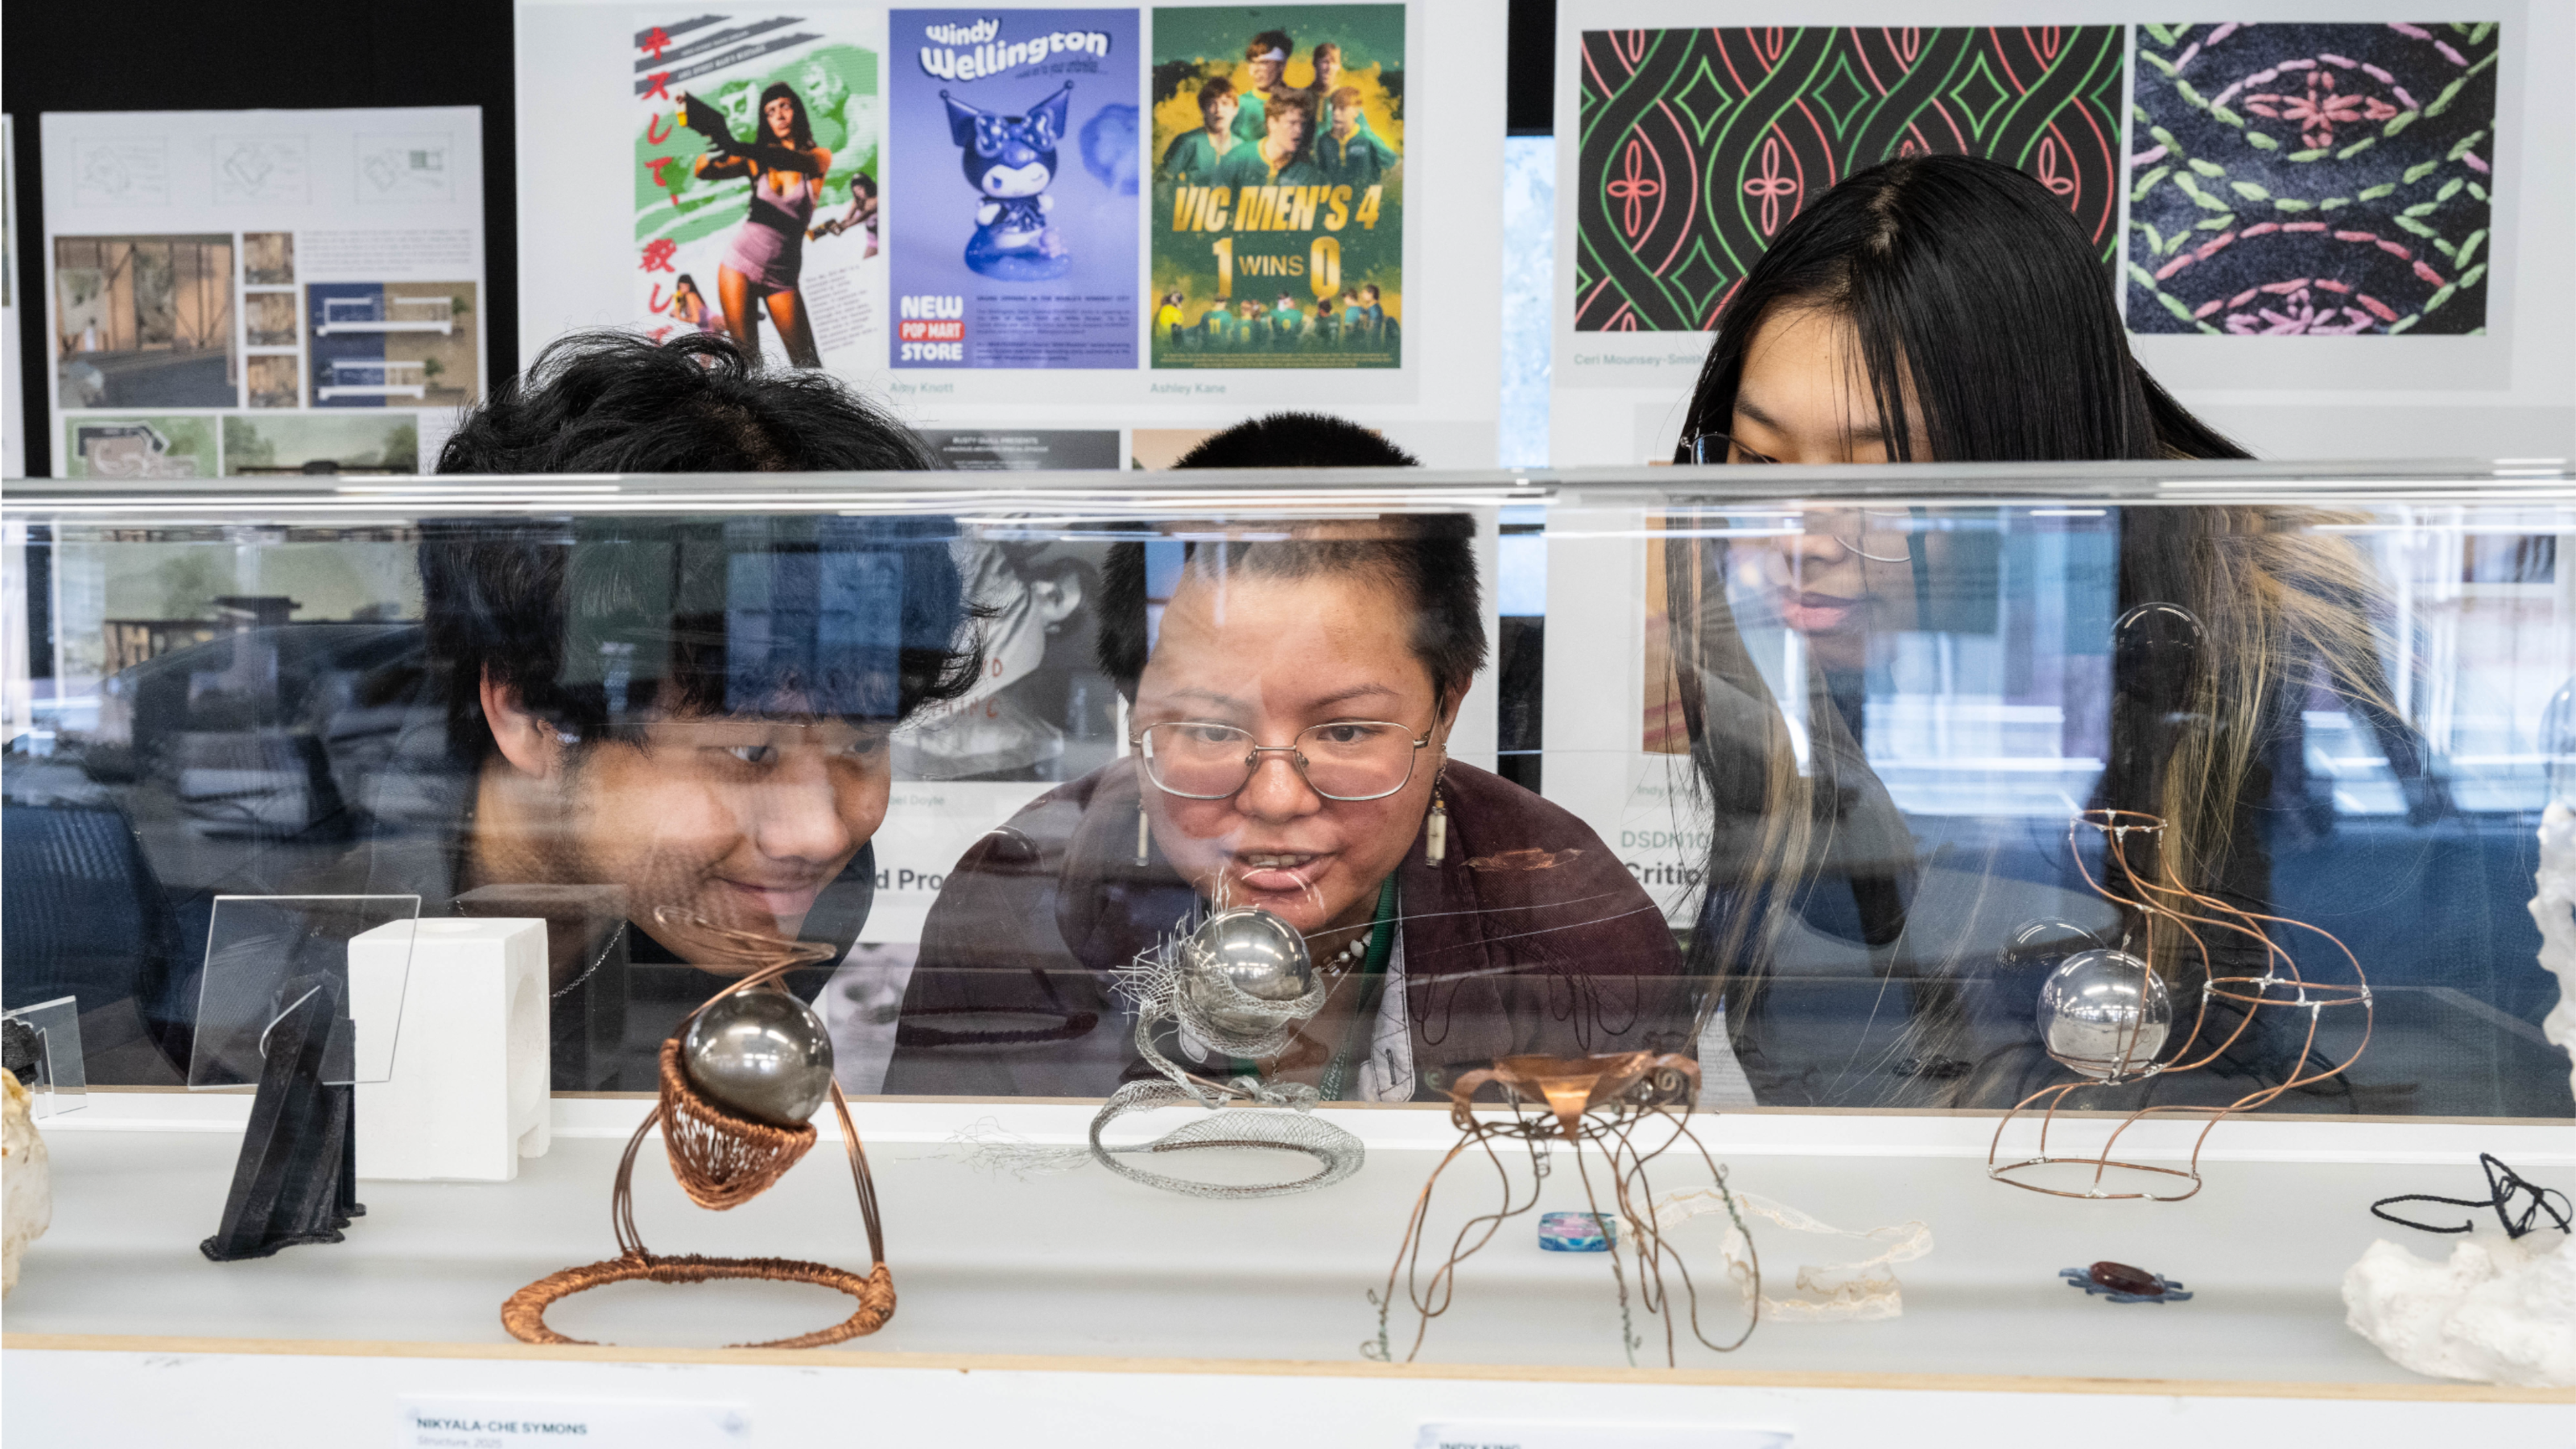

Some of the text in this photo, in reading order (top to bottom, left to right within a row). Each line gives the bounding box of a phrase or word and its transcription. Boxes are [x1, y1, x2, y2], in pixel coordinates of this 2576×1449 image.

[925, 18, 1001, 46] Windy
[919, 30, 1110, 81] Wellington
[1172, 184, 1383, 232] VIC MEN'S 4
[1212, 237, 1233, 298] 1
[1238, 254, 1304, 276] WINS
[900, 295, 964, 320] NEW
[902, 321, 962, 340] POP MART
[900, 342, 964, 361] STORE
[1574, 353, 1598, 365] Ceri
[890, 382, 954, 395] Amy Knott
[1150, 382, 1227, 396] Ashley Kane
[522, 1422, 588, 1435] SYMONS
